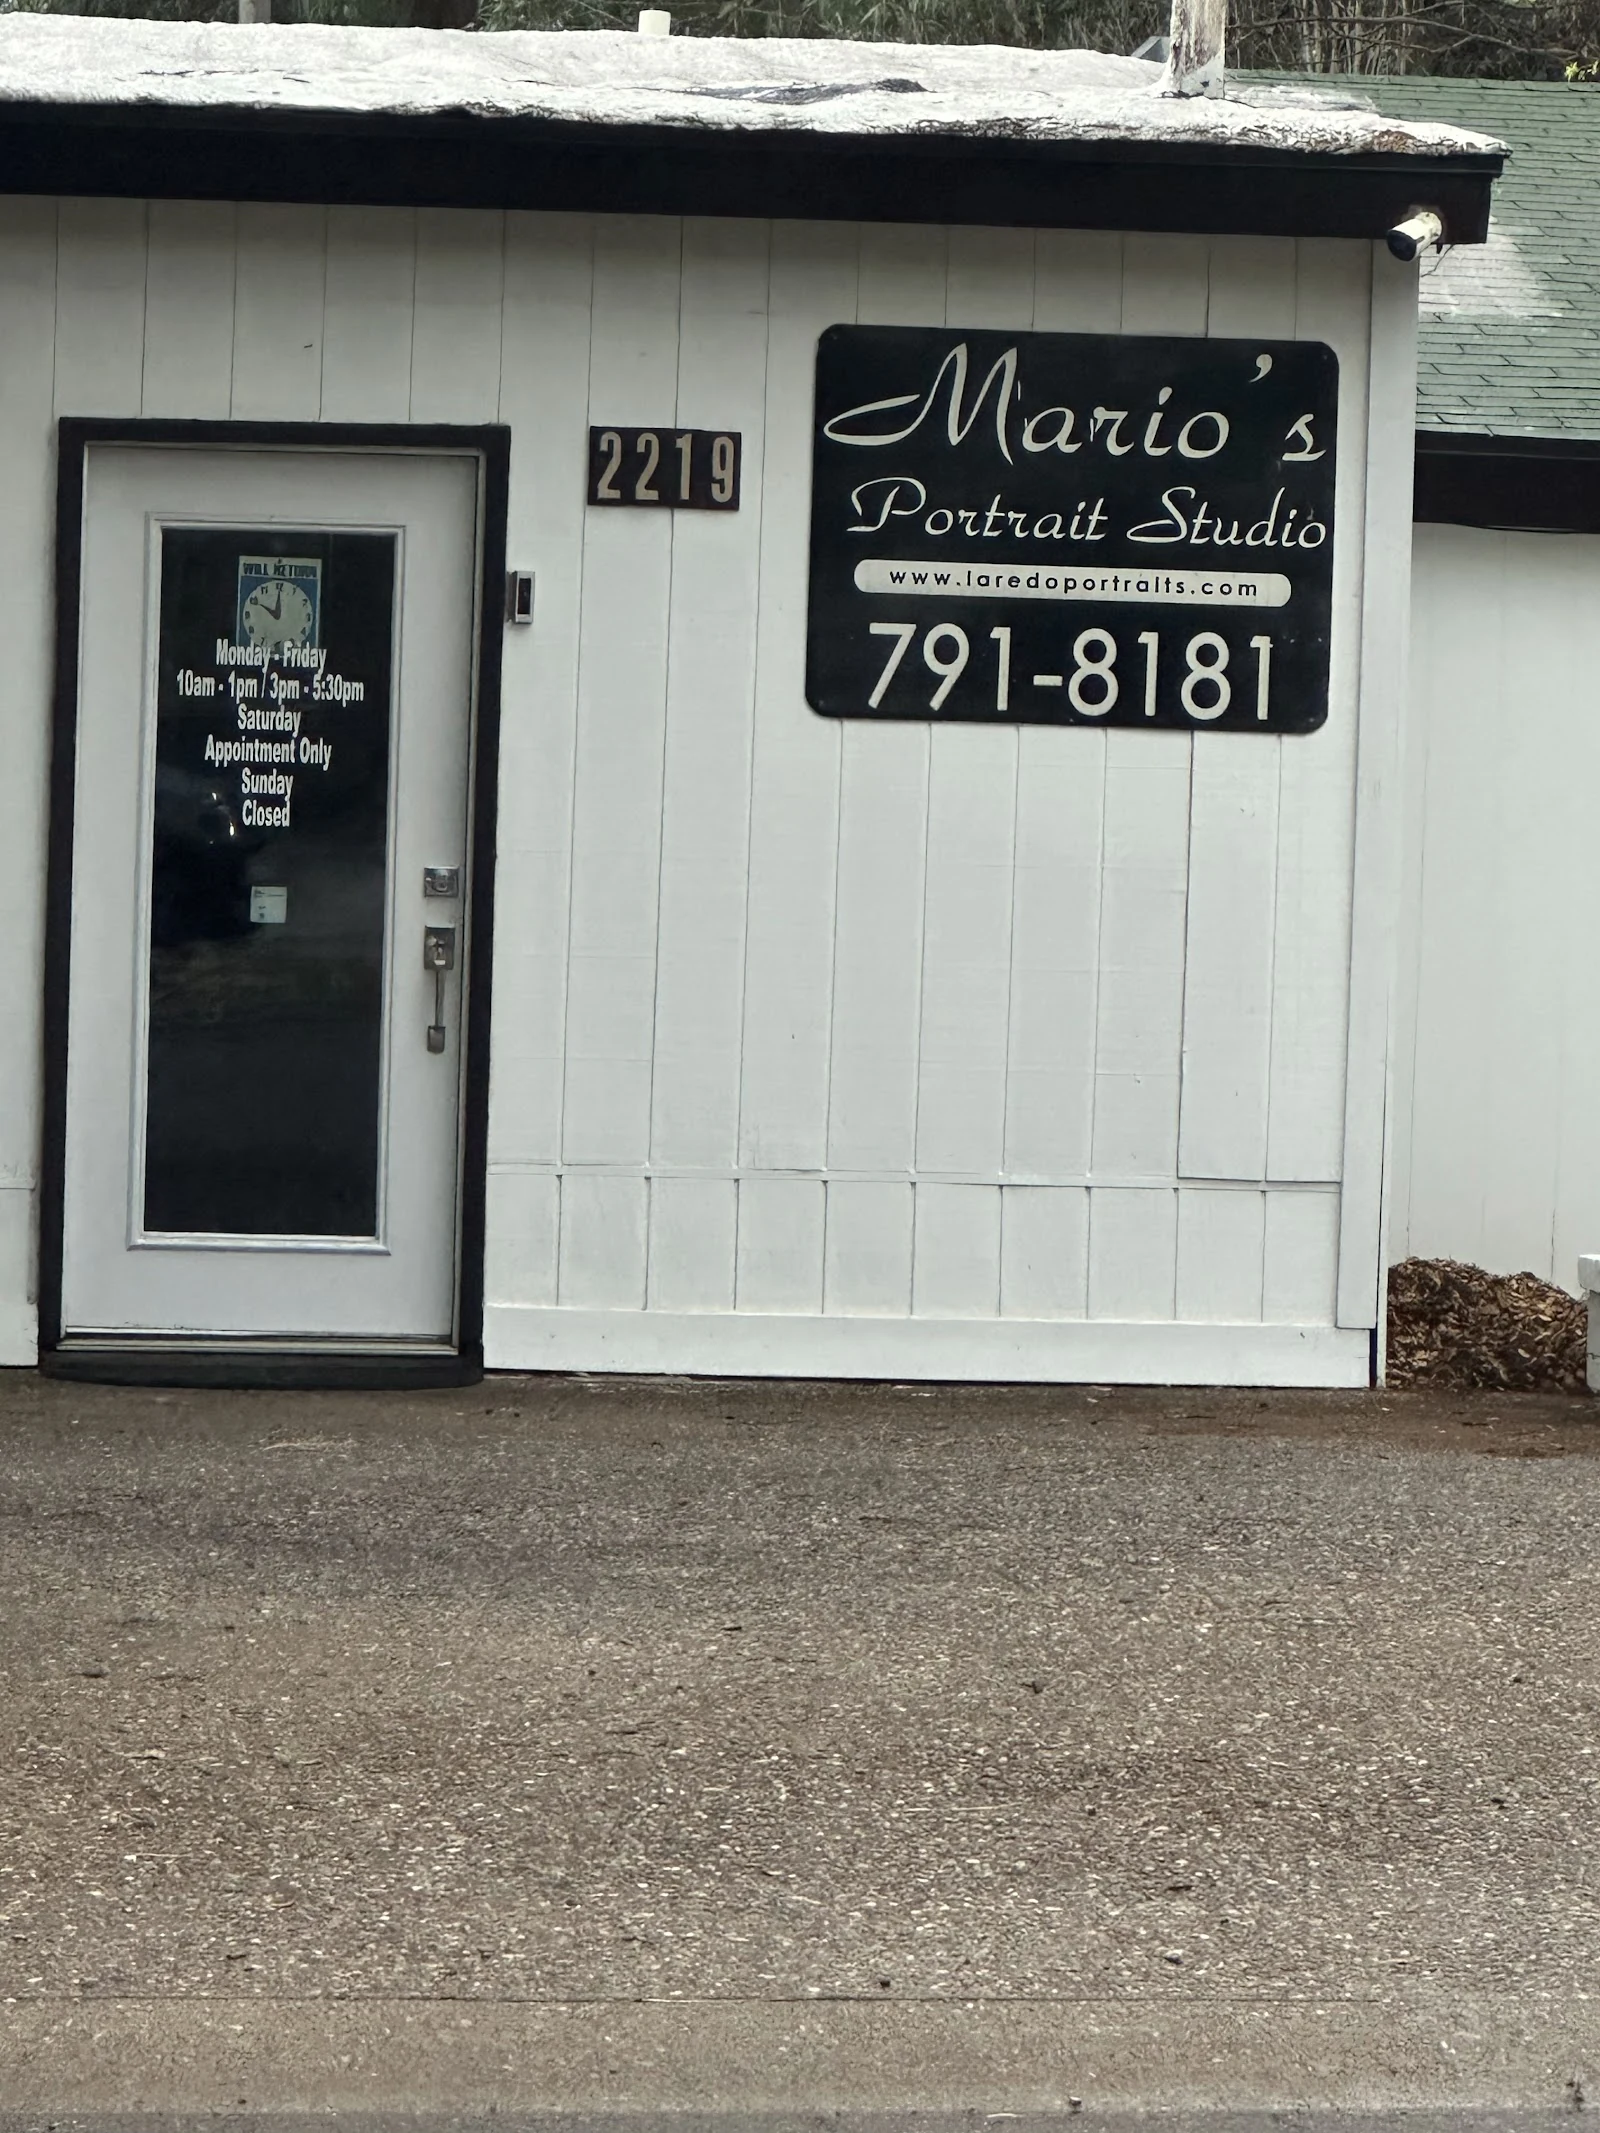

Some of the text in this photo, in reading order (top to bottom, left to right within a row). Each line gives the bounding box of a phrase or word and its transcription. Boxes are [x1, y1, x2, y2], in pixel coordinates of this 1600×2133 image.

[823, 342, 1326, 465] Mario's
[597, 431, 735, 503] 2219
[846, 476, 1327, 549] Portrait Studio
[216, 638, 271, 673] Monday
[282, 641, 327, 674] Friday
[868, 622, 1274, 721] 791-8181
[177, 669, 215, 696] 10am
[228, 671, 258, 703] 1pm
[270, 673, 300, 705] 3pm
[312, 674, 364, 707] 5:30pm
[237, 703, 302, 737] Saturday
[204, 734, 332, 771] Appointment Only
[241, 767, 294, 801] Sunday
[242, 799, 290, 828] Closed
